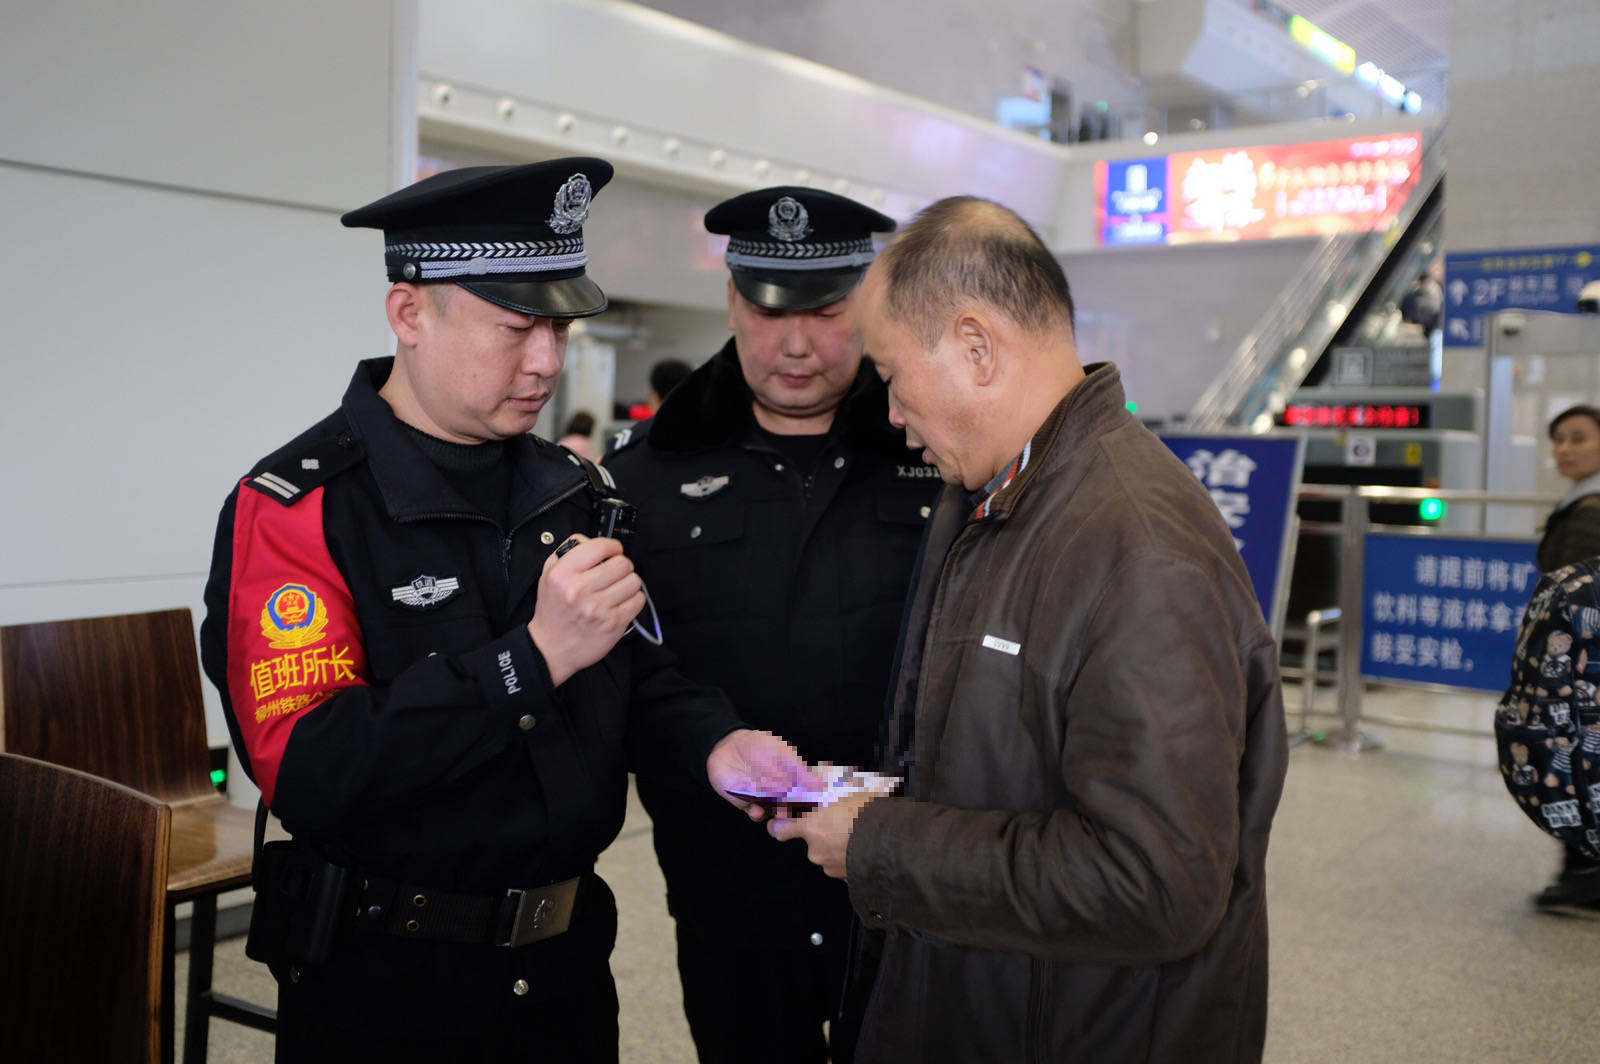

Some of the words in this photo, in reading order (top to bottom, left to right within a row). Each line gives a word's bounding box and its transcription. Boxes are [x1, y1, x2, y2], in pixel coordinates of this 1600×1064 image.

[1473, 278, 1506, 305] 2F
[250, 644, 356, 701] 值班所长
[498, 650, 522, 695] POLICE
